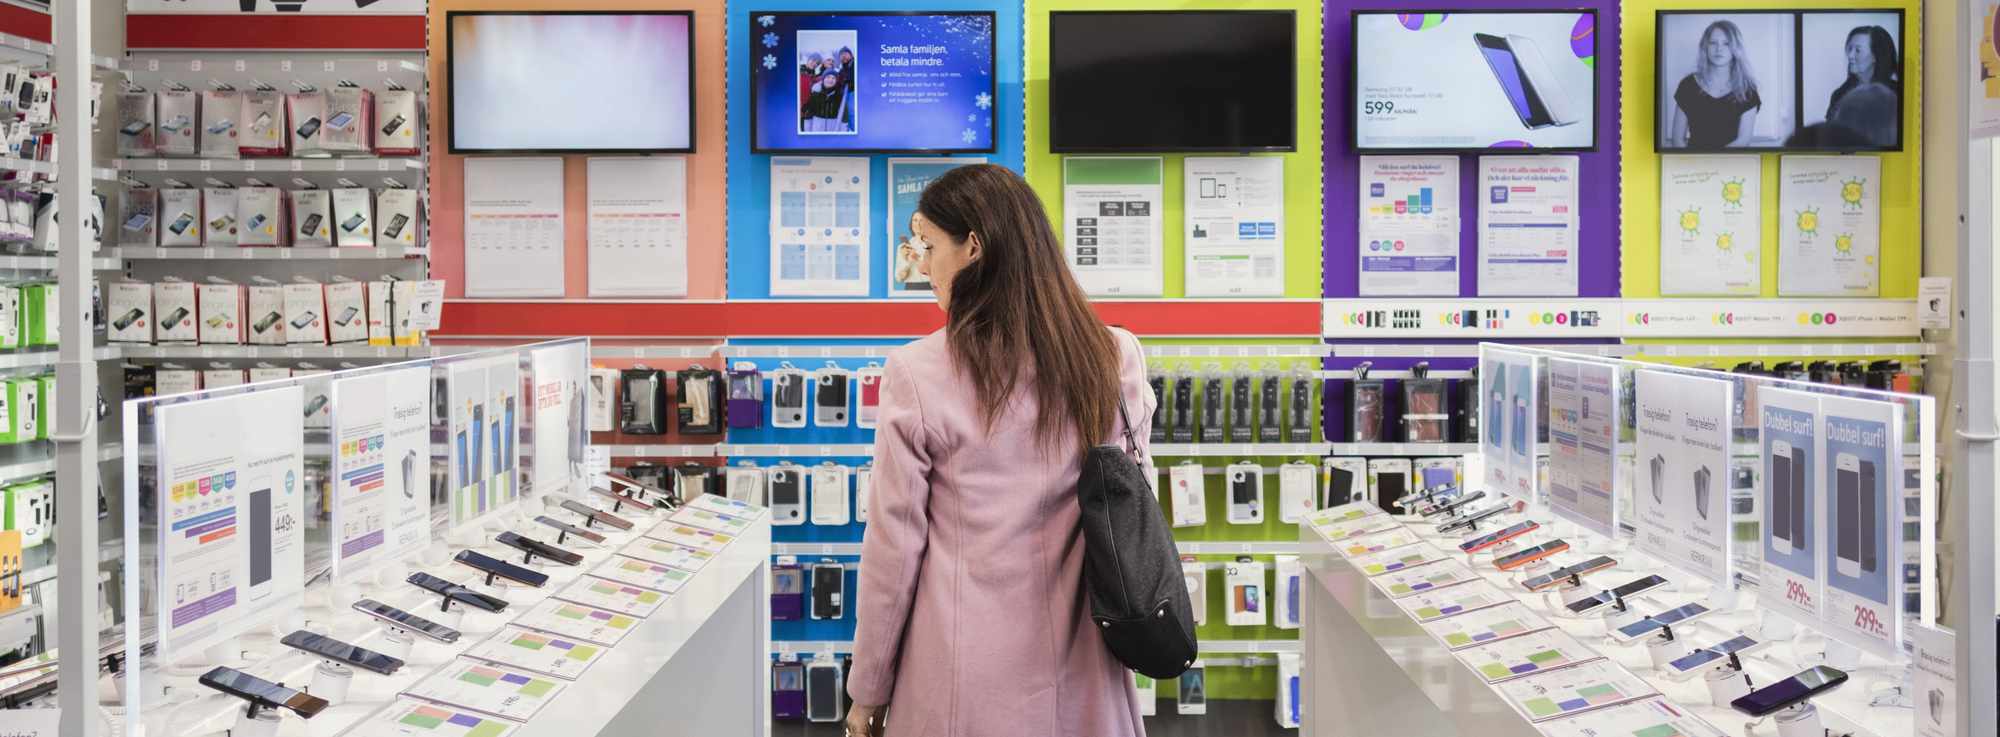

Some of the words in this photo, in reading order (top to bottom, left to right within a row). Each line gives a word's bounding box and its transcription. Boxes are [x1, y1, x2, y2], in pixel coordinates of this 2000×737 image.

[880, 44, 909, 54] Samla
[910, 44, 949, 56] familjen,
[880, 57, 909, 66] betala
[911, 57, 944, 66] mindre.
[1365, 101, 1394, 114] 599
[1765, 411, 1792, 433] Dubbel
[1793, 418, 1813, 437] surf!
[1827, 422, 1861, 444] Dubbel
[1862, 427, 1885, 449] surf!
